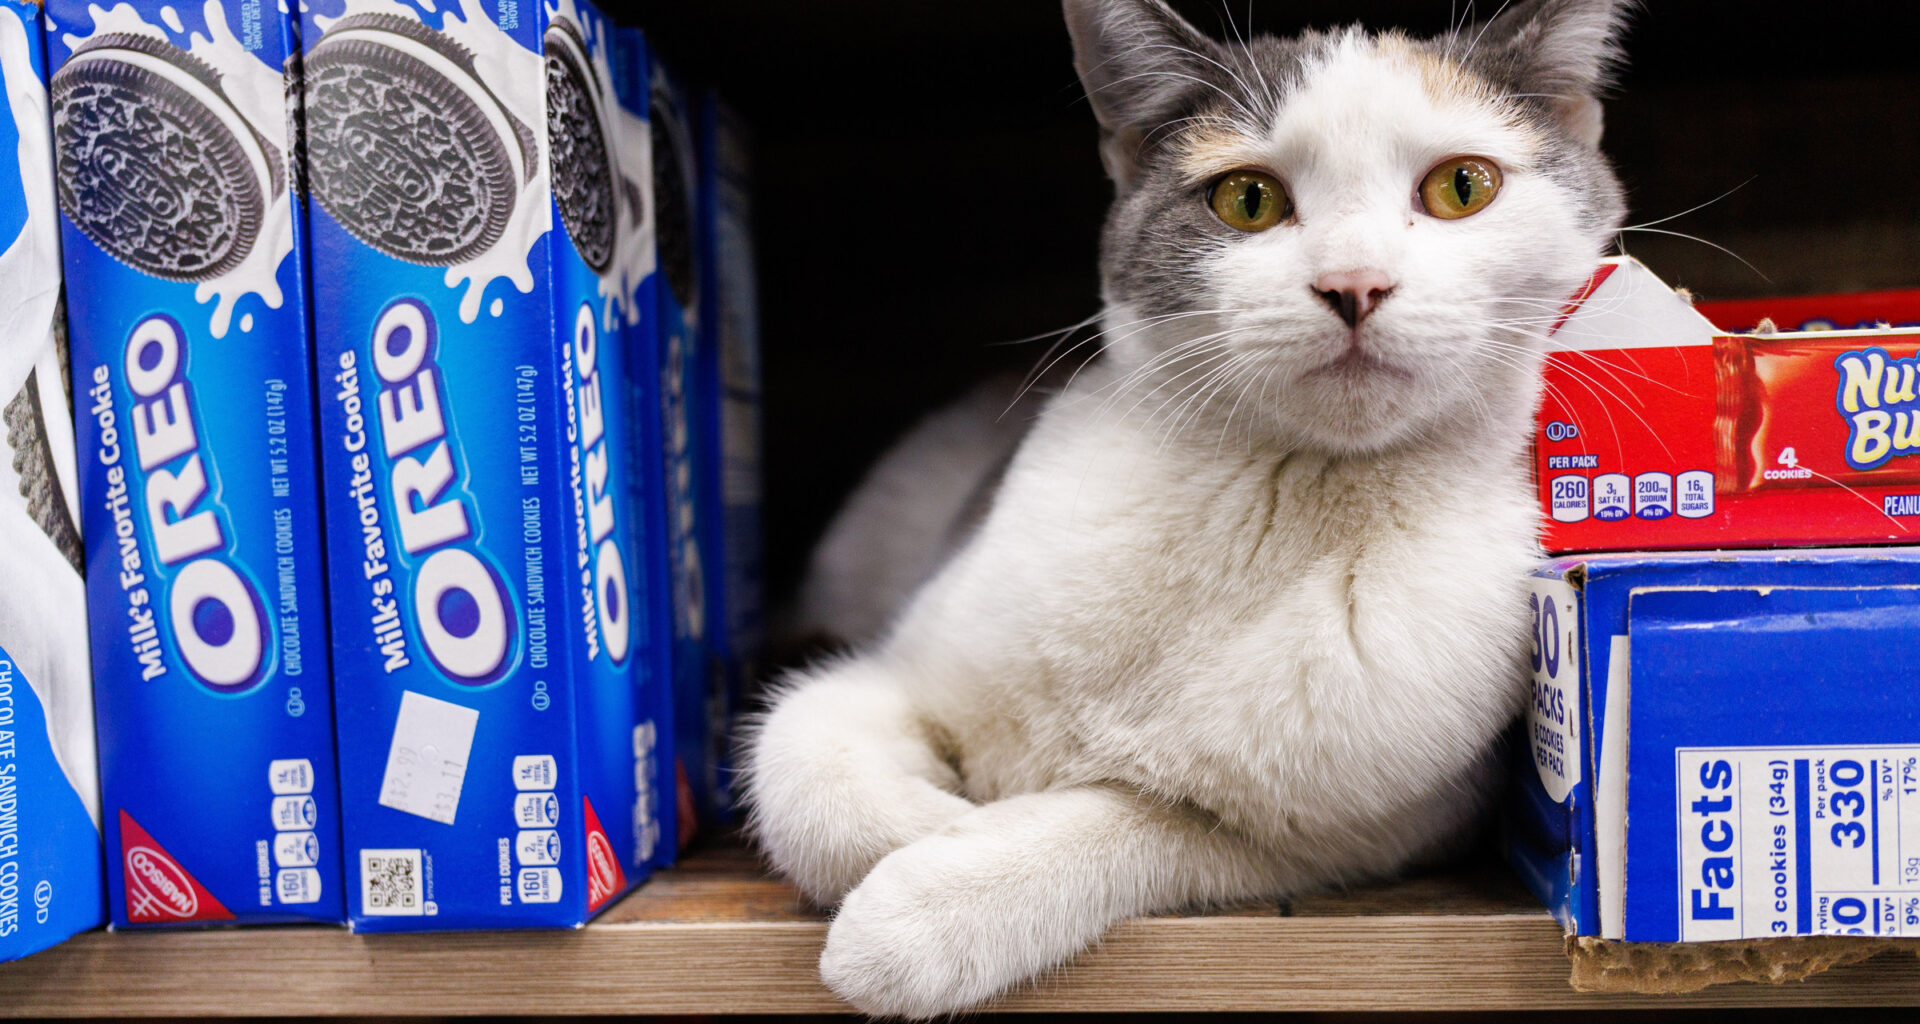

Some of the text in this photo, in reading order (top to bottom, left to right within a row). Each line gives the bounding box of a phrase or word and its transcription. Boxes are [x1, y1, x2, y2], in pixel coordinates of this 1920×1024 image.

[508, 0, 519, 29] SHOW
[1841, 353, 1920, 413] Nu
[264, 379, 290, 497] NET WT 5.2 OZ (147g)
[515, 365, 539, 485] NET WT 5.2 OZ (147g)
[1852, 409, 1920, 464] Bu
[1549, 455, 1598, 468] PER PACK
[1777, 446, 1798, 468] 4
[575, 302, 630, 663] OREO
[1554, 481, 1586, 499] 260
[1606, 483, 1617, 496] 3g
[1638, 481, 1668, 494] 200mg
[1686, 479, 1704, 492] 16g
[1763, 469, 1812, 480] COOKIES
[124, 316, 265, 690] OREO
[371, 301, 510, 681] OREO
[1554, 500, 1586, 509] CALORIES
[1598, 495, 1625, 505] SAT FAT
[1639, 494, 1667, 503] SODIUM
[1681, 502, 1709, 511] SUGARS
[1684, 493, 1705, 501] TOTAL
[1884, 495, 1920, 515] PEANU
[89, 364, 167, 682] Milk's Favorite Cookie
[335, 350, 410, 674] Milk's Favorite Cookie
[274, 508, 302, 676] CHOCOLATE SANDWICH COOKIES
[522, 497, 548, 669] CHOCOLATE SANDWICH COOKIES
[1530, 592, 1560, 679] 30
[1531, 679, 1565, 726] PACKS
[1538, 724, 1564, 755] COOKIES
[1536, 746, 1565, 779] PER PACK
[1902, 757, 1918, 795] 17%
[0, 660, 19, 937] CHOCOLATE SANDWICH COOKIES
[1815, 758, 1828, 819] Per pack
[1829, 759, 1867, 849] 330
[1691, 759, 1735, 921] Facts
[1768, 759, 1790, 934] 3 cookies (34g)
[133, 852, 193, 912] NABISCO
[283, 872, 300, 897] 160
[500, 876, 511, 886] 3
[524, 872, 541, 898] 160
[1904, 856, 1920, 884] 13g
[500, 885, 512, 905] PER
[1904, 897, 1920, 926] 9%
